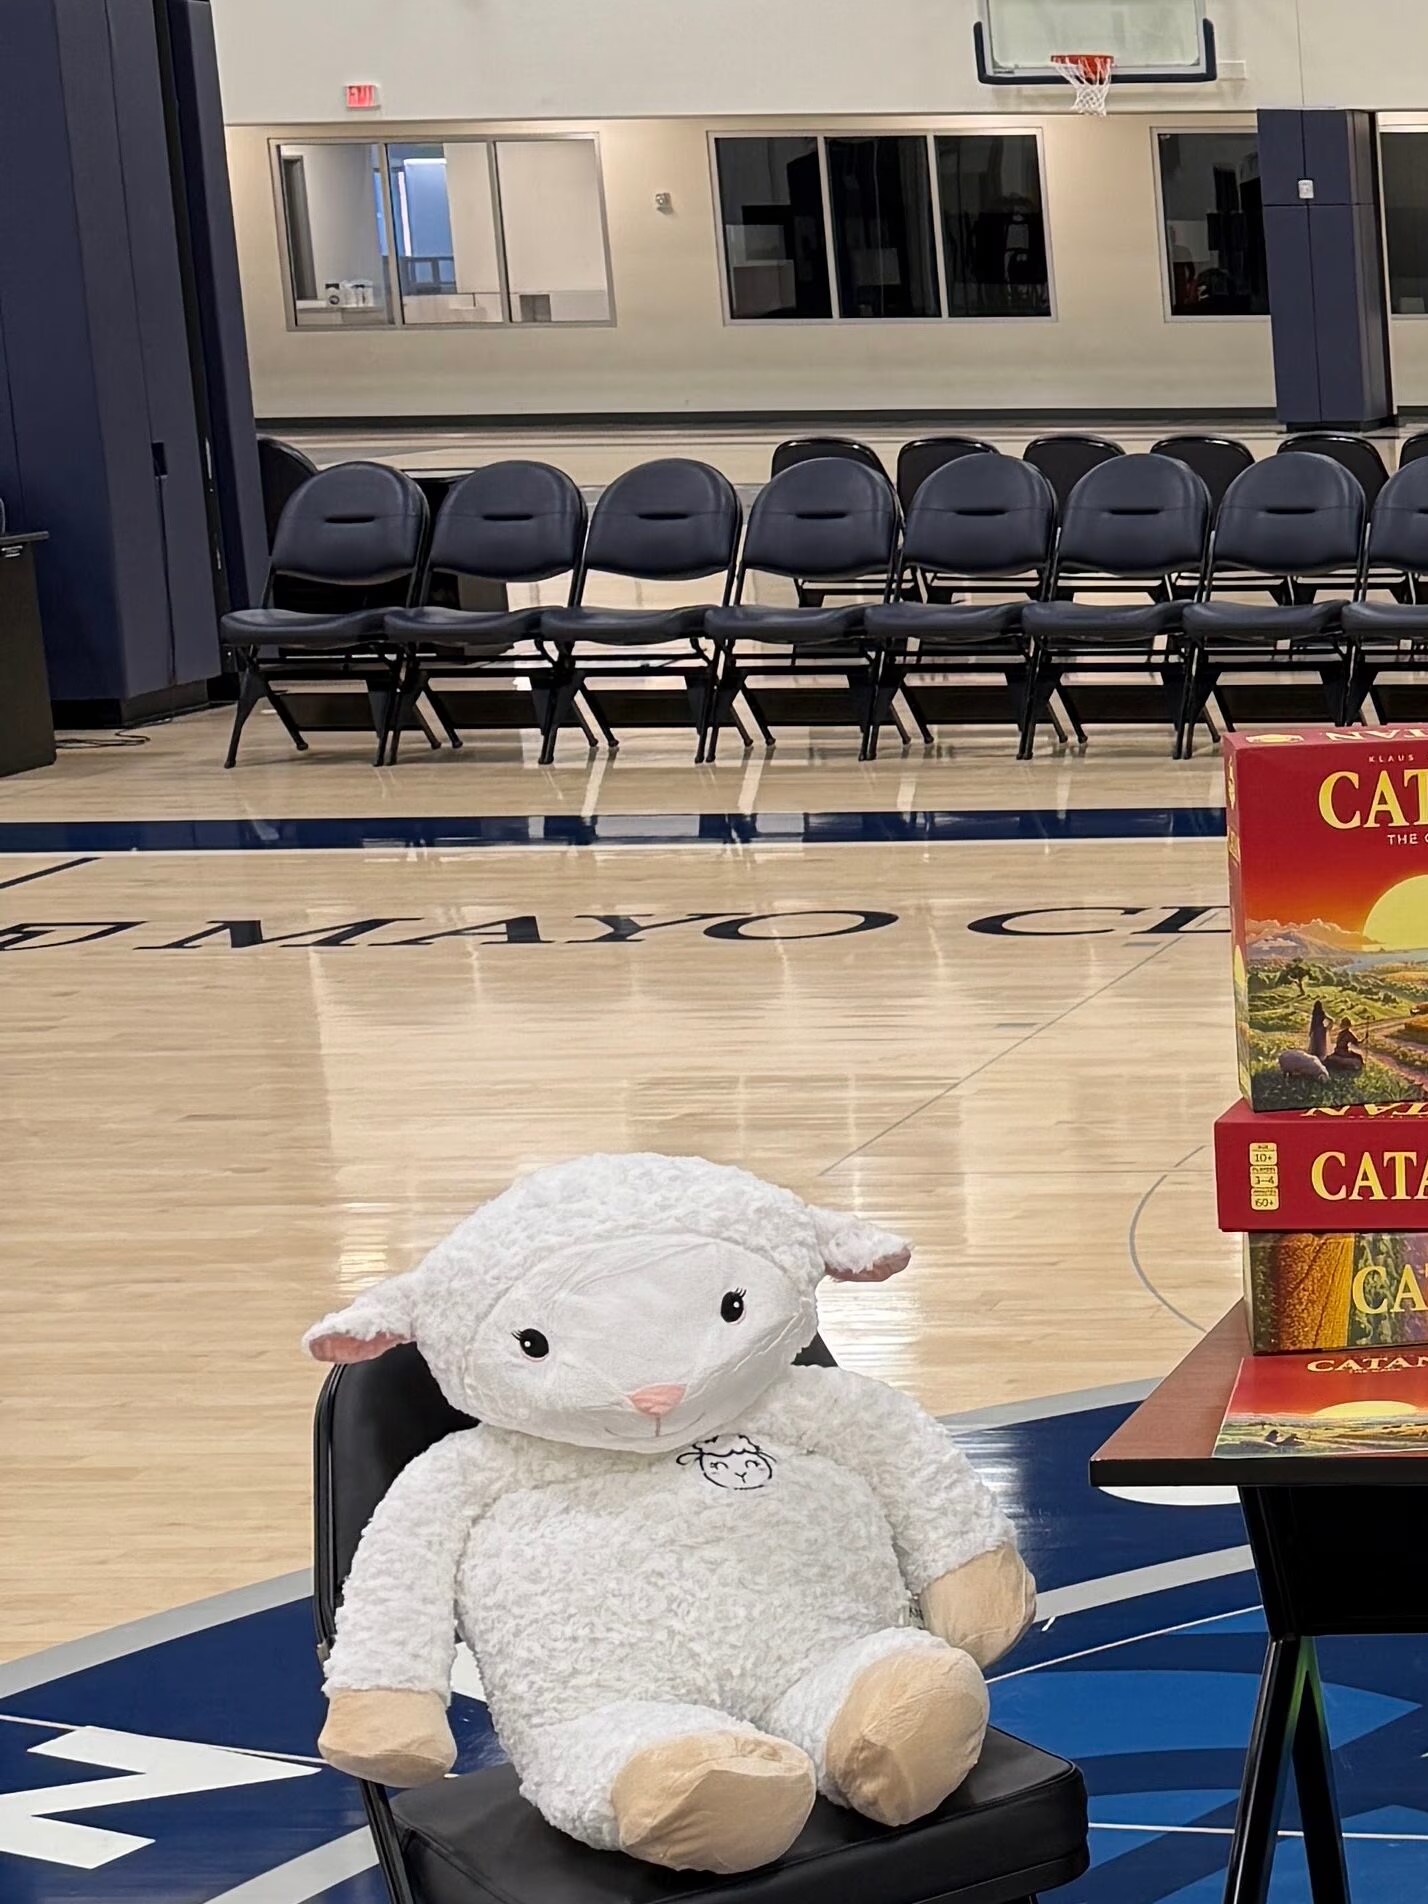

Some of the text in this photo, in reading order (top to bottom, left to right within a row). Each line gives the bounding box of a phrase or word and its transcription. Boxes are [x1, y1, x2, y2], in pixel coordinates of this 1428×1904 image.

[1368, 754, 1415, 764] KLAUS
[1387, 833, 1419, 846] THE
[133, 910, 899, 949] MAYO
